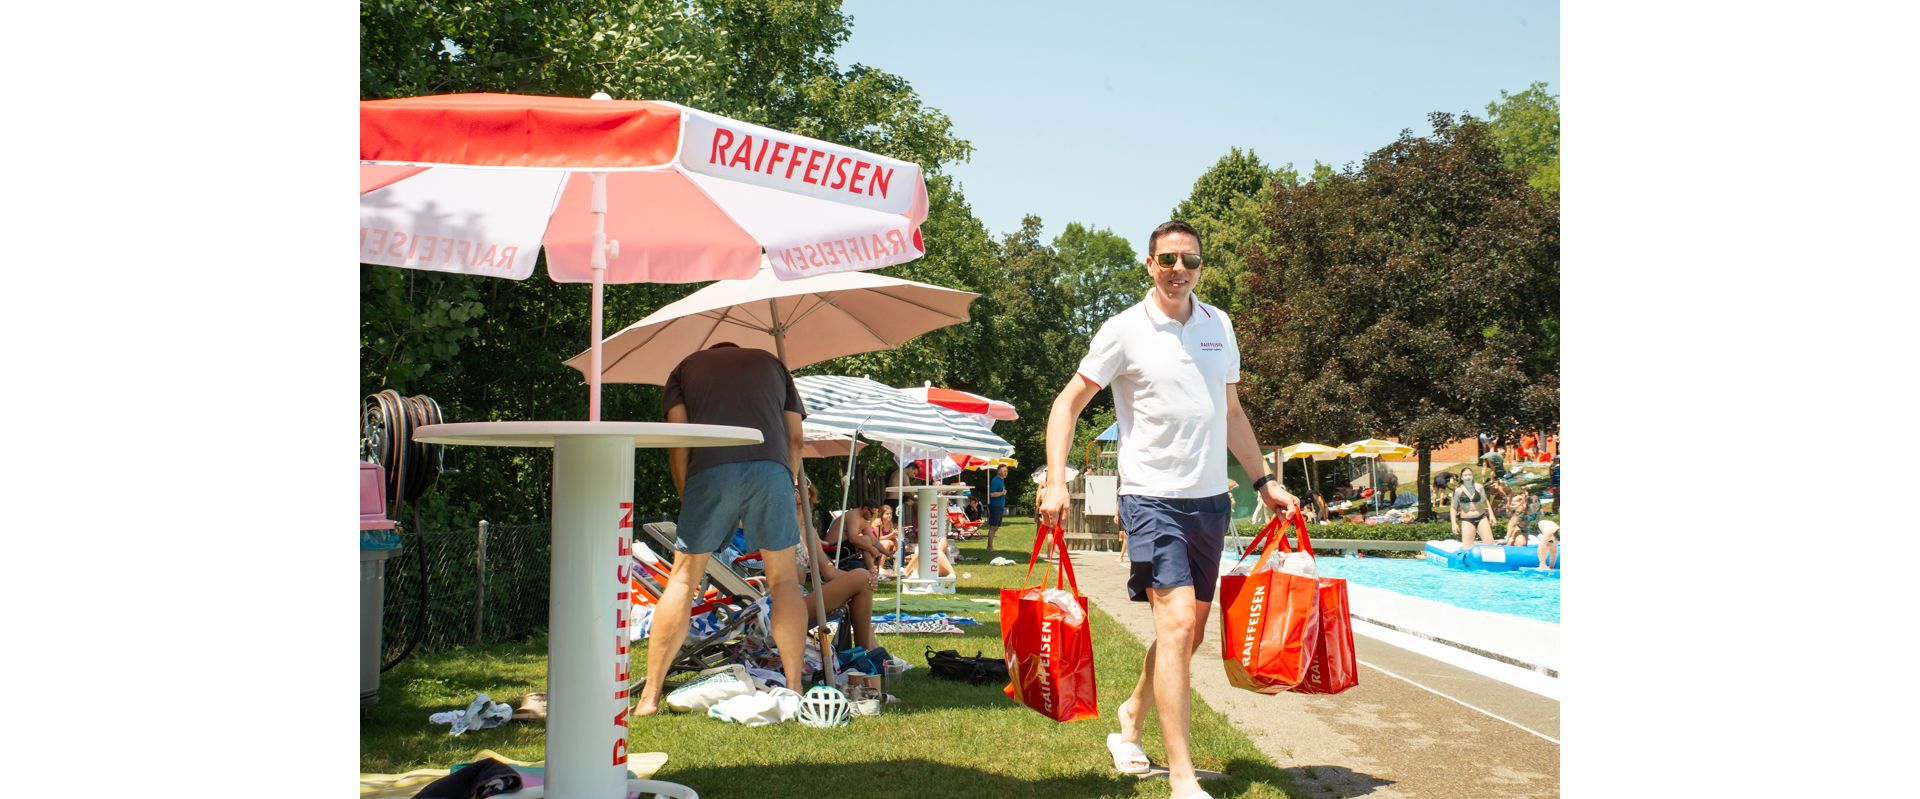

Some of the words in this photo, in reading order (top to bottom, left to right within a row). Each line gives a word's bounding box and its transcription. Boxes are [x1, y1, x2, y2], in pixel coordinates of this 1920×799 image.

[709, 128, 894, 199] RAIFFEISEN
[930, 503, 938, 573] RAIFFEISEN
[1242, 585, 1265, 667] RAIFFEISEN
[1040, 621, 1052, 713] RAIFFEISEN
